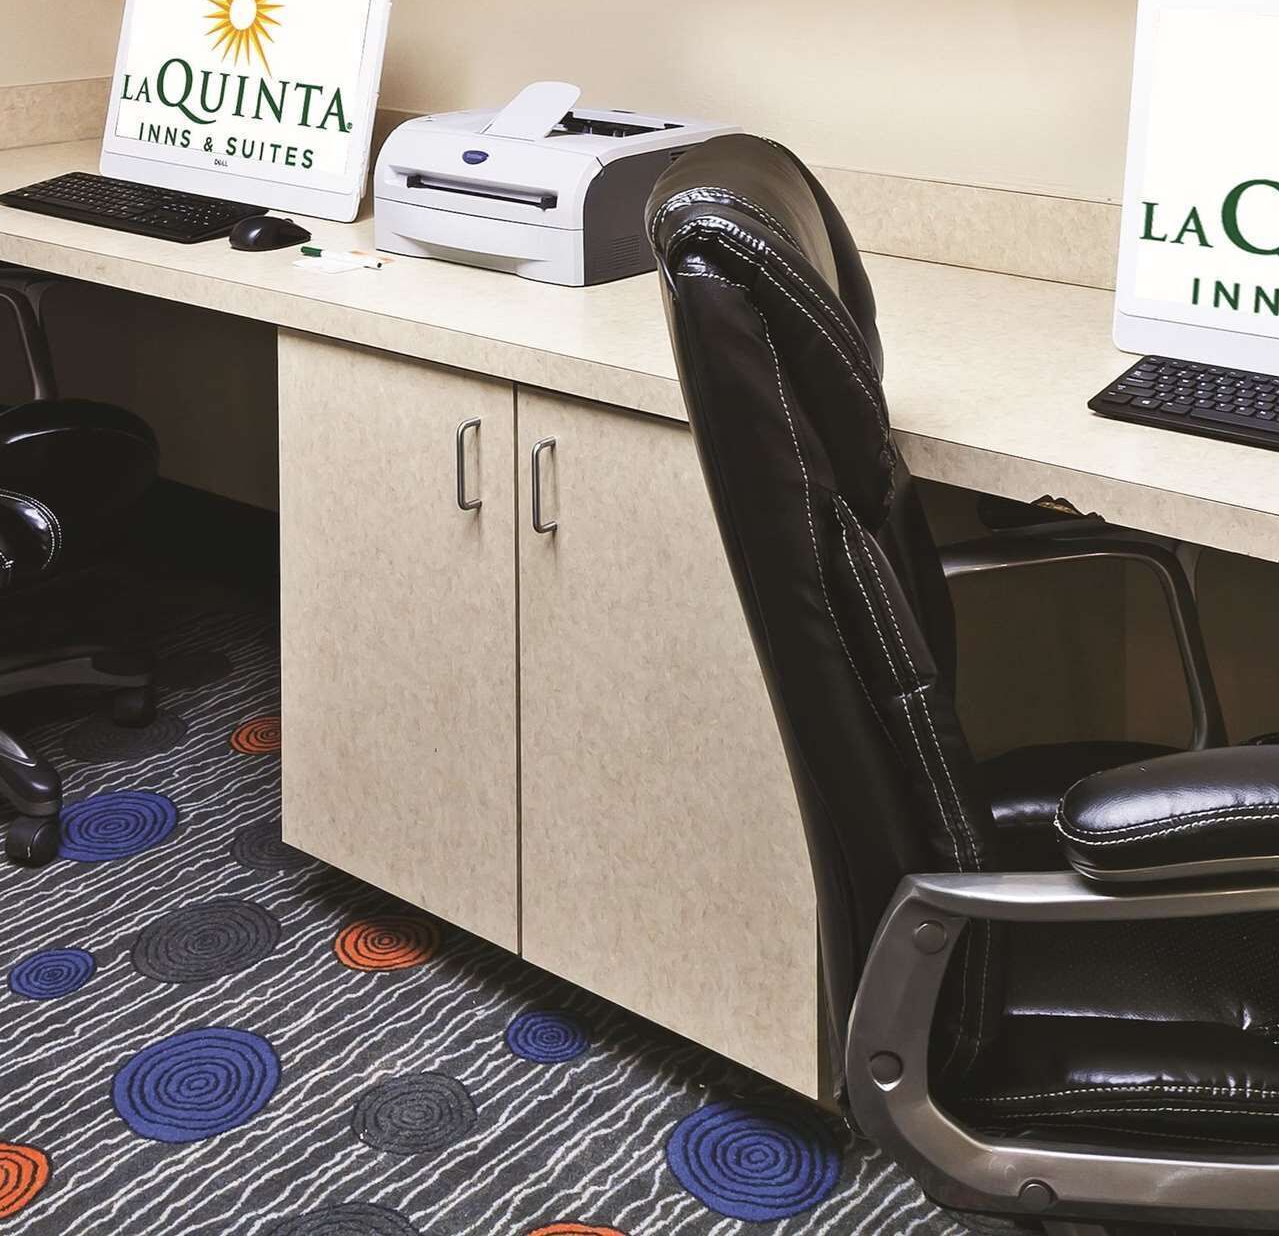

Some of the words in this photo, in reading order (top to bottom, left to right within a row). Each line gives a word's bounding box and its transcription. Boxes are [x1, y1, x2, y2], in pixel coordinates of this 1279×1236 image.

[120, 74, 152, 104] LA
[156, 58, 350, 134] QUINTA
[138, 122, 191, 149] INNS
[203, 136, 214, 153] &
[225, 136, 314, 170] SUITES
[1140, 201, 1214, 249] LA
